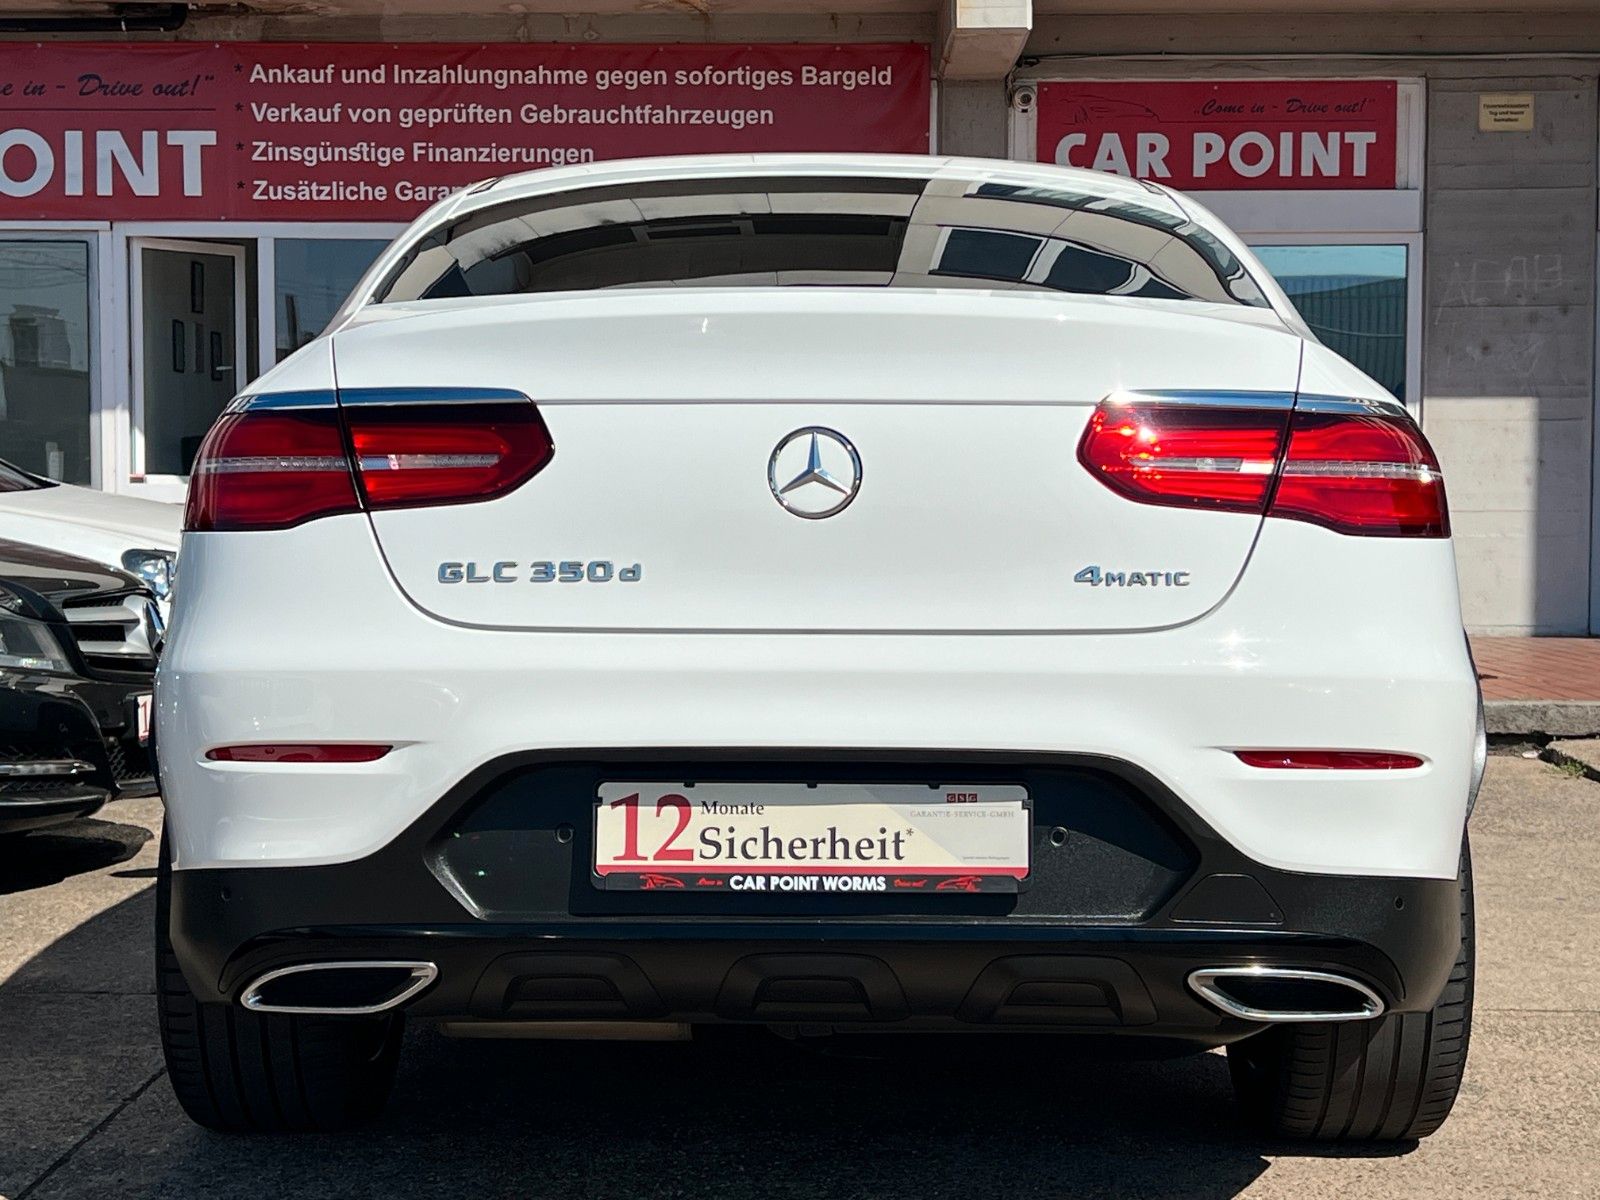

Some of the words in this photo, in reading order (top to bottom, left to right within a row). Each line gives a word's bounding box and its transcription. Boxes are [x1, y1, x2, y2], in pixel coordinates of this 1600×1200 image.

[78, 73, 144, 96] Drive
[249, 64, 335, 84] Ankauf
[341, 64, 386, 84] und
[394, 64, 587, 90] Inzahlungnahme
[595, 68, 667, 90] gegen
[674, 66, 793, 90] sofortiges
[801, 66, 893, 90] Bargeld
[250, 103, 342, 123] Verkauf
[348, 107, 391, 123] von
[399, 103, 513, 128] geprüften
[520, 104, 774, 129] Gebrauchtfahrzeugen
[1286, 98, 1328, 114] Drive
[251, 141, 405, 167] Zinsgünstige
[412, 142, 595, 167] Finanzierungen
[1054, 132, 1172, 178] CAR
[1193, 131, 1376, 178] POINT
[252, 180, 388, 201] Zusätzliche
[438, 561, 518, 583] GLC
[1074, 566, 1190, 587] 4MATIC
[700, 800, 764, 816] Monate
[610, 792, 694, 861] 12
[729, 875, 766, 891] CAR
[770, 875, 819, 891] POINT
[822, 875, 886, 891] WORMS
